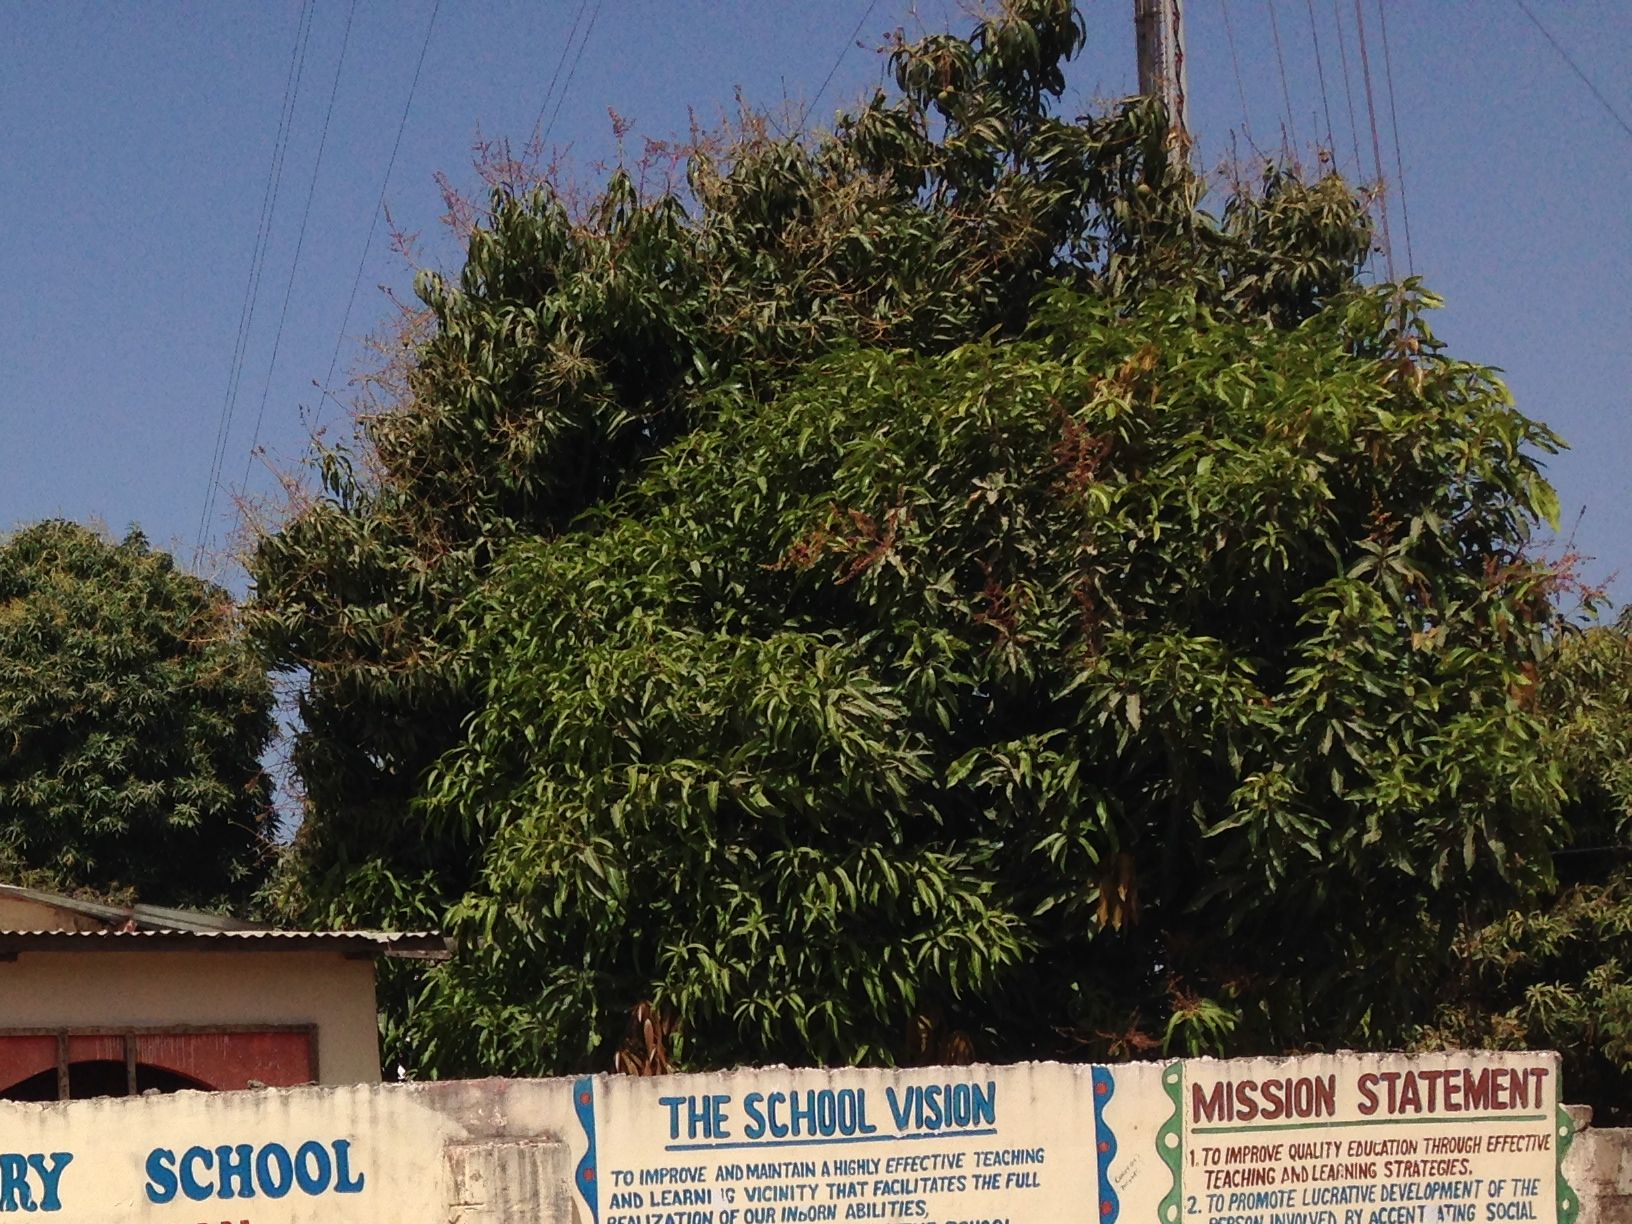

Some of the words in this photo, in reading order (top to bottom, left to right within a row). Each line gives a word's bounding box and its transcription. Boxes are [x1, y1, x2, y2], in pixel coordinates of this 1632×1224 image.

[659, 1094, 731, 1140] THE
[744, 1087, 877, 1139] SCHOOL
[886, 1081, 996, 1131] VISION
[1192, 1074, 1336, 1124] MISSION
[1358, 1067, 1549, 1115] STATEMENT
[611, 1170, 633, 1187] TO
[640, 1166, 707, 1185] IMPROVE
[715, 1163, 744, 1182] AND
[746, 1161, 816, 1180] MAINTAIN
[821, 1160, 831, 1177] A
[834, 1157, 881, 1176] HIGHLY
[886, 1152, 965, 1174] EFFECTIVE
[974, 1148, 1045, 1168] TEACHING
[1190, 1149, 1199, 1167] 1.
[1202, 1147, 1221, 1167] TO
[1225, 1144, 1284, 1165] IMPROVE
[1289, 1141, 1342, 1161] QUALITY
[1348, 1139, 1418, 1157] EDUCATION
[1424, 1136, 1482, 1155] THROUGH
[1487, 1134, 1551, 1153] EFFECTIVE
[146, 1139, 364, 1204] SCHOOL
[1205, 1168, 1276, 1190] TEACHING
[1281, 1165, 1309, 1184] AND
[1384, 1159, 1473, 1178] STRATEGIES.
[609, 1191, 643, 1210] AND
[744, 1184, 819, 1203] VICINITY
[826, 1181, 869, 1199] THAT
[873, 1175, 966, 1197] FACILITATES
[971, 1173, 1002, 1190] THE
[1005, 1172, 1040, 1188] FULL
[1187, 1196, 1202, 1214] 2.
[1207, 1195, 1224, 1213] TO
[1228, 1189, 1297, 1211] PROMOTE
[1302, 1185, 1377, 1205] LUCRATIVE
[1380, 1180, 1483, 1202] DEVELOPMENT
[1488, 1180, 1506, 1198] OF
[1511, 1179, 1540, 1196] THE
[743, 1207, 776, 1224] OUR
[845, 1200, 929, 1220] ABILITIES,
[1486, 1201, 1537, 1222] SOCIAL
